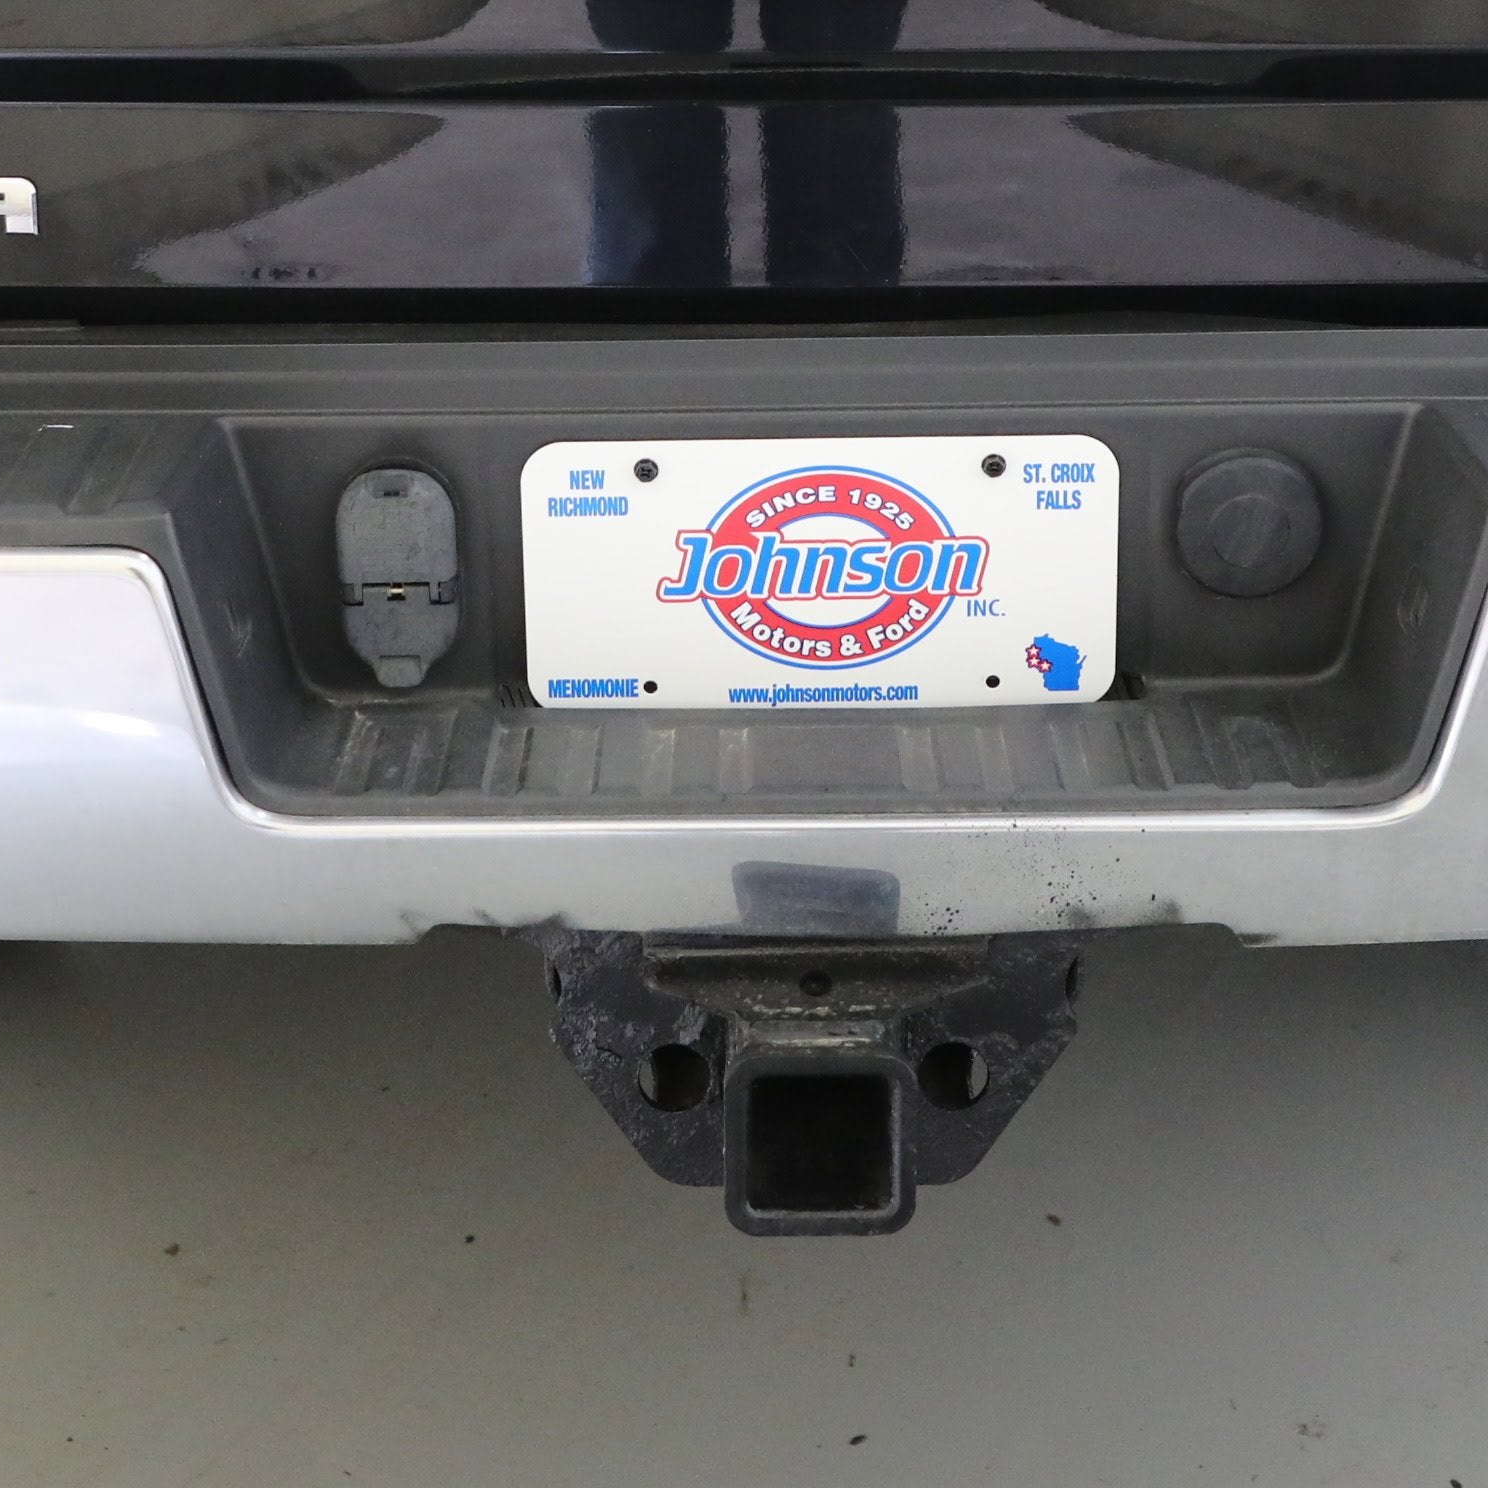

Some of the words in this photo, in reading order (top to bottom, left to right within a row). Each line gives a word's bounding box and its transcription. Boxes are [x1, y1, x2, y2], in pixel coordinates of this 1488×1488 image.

[569, 470, 605, 490] NEW
[1023, 463, 1049, 484] ST.
[1052, 462, 1096, 484] CROIX
[548, 496, 629, 517] RICHMOND
[745, 484, 837, 530] SINCE
[849, 487, 916, 531] 1925
[1036, 489, 1082, 511] FALLS
[659, 530, 988, 601] Johnson
[966, 599, 1007, 618] INC.
[729, 600, 833, 659] Motors
[838, 635, 864, 659] &
[867, 599, 931, 652] Ford
[548, 678, 639, 700] MENOMONIE
[728, 684, 919, 708] www.johnsonmotors.com
